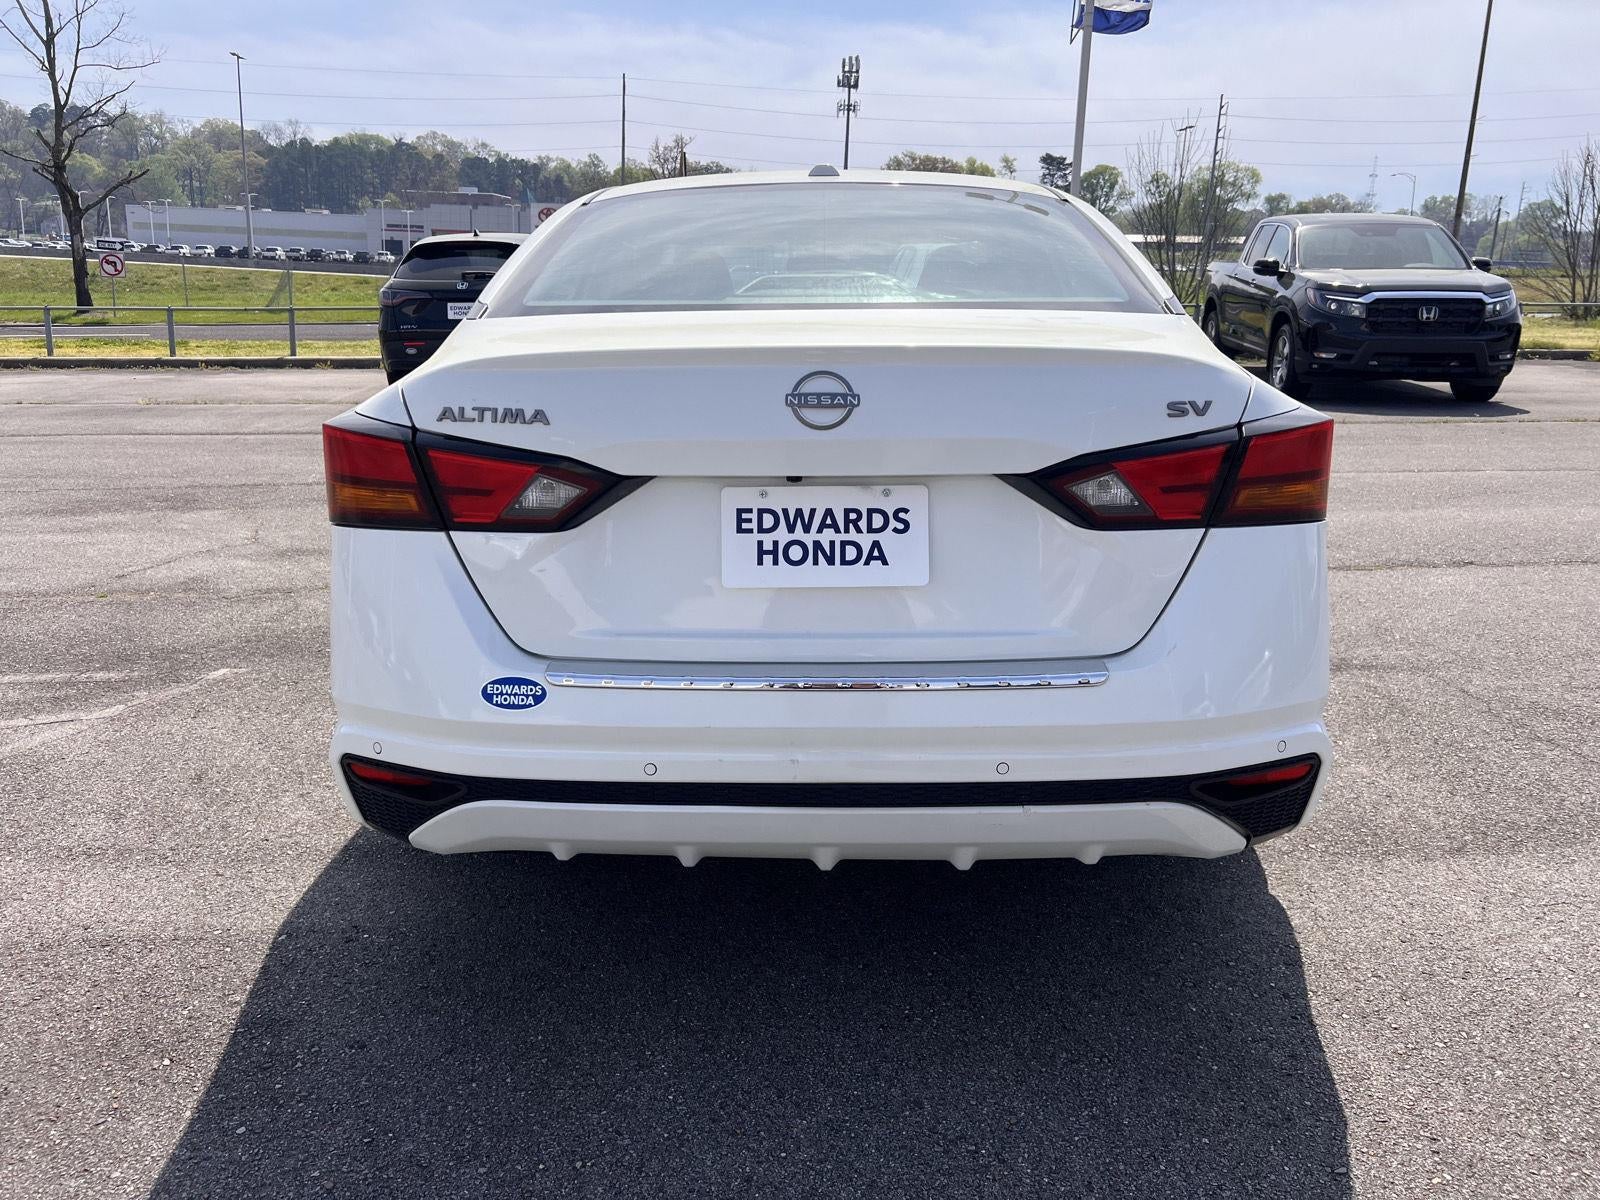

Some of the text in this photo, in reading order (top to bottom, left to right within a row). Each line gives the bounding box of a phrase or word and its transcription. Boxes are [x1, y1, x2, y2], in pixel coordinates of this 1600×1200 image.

[787, 395, 859, 405] NISSAN
[1166, 400, 1213, 418] SV
[436, 406, 550, 425] ALTIMA
[735, 507, 911, 535] EDWARDS
[756, 539, 890, 567] HONDA
[487, 684, 542, 695] EDWARDS
[493, 695, 535, 706] HONDA
